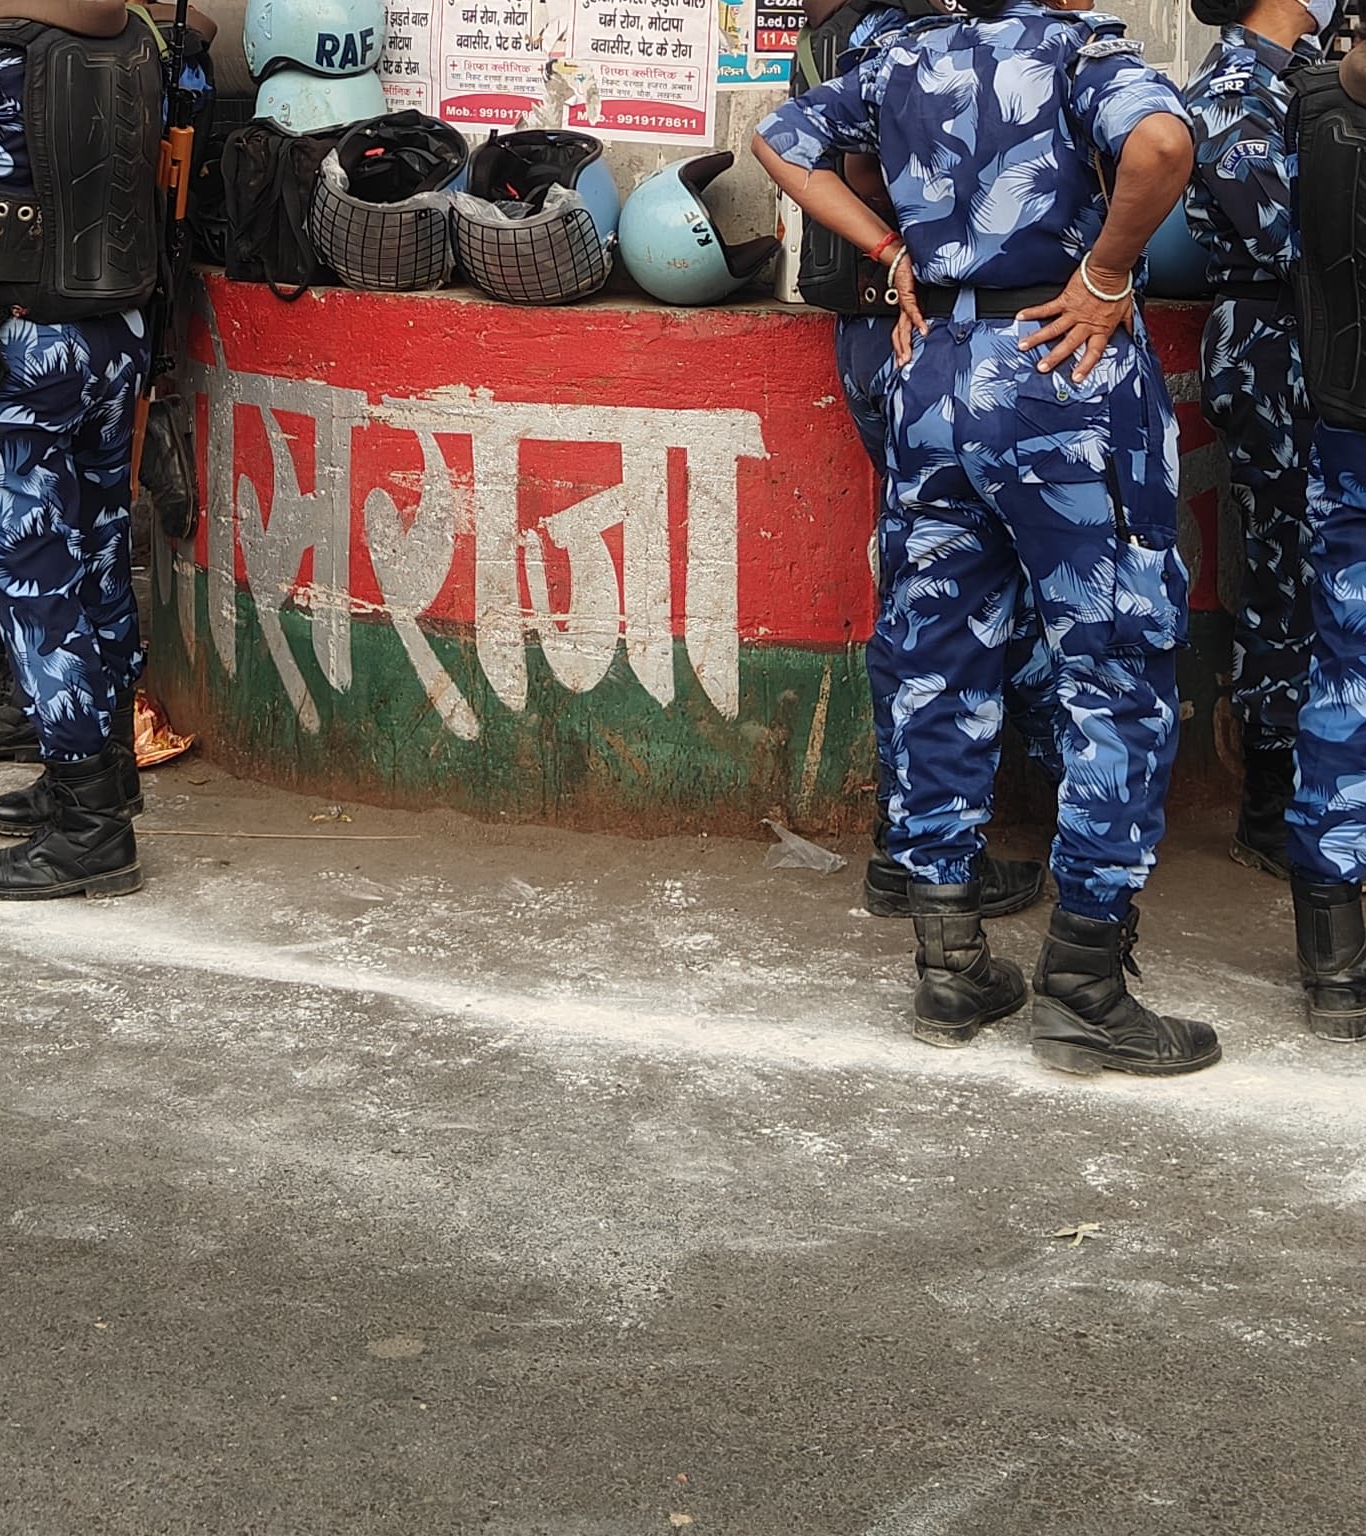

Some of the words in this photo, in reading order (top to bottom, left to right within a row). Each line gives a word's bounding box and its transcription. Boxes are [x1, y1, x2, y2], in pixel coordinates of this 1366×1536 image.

[647, 10, 684, 33] मोटापा
[313, 26, 375, 72] RAF
[656, 36, 668, 58] के
[671, 37, 692, 59] रोग
[761, 32, 778, 47] 11
[617, 113, 698, 129] 9919178611
[683, 210, 714, 249] RAF
